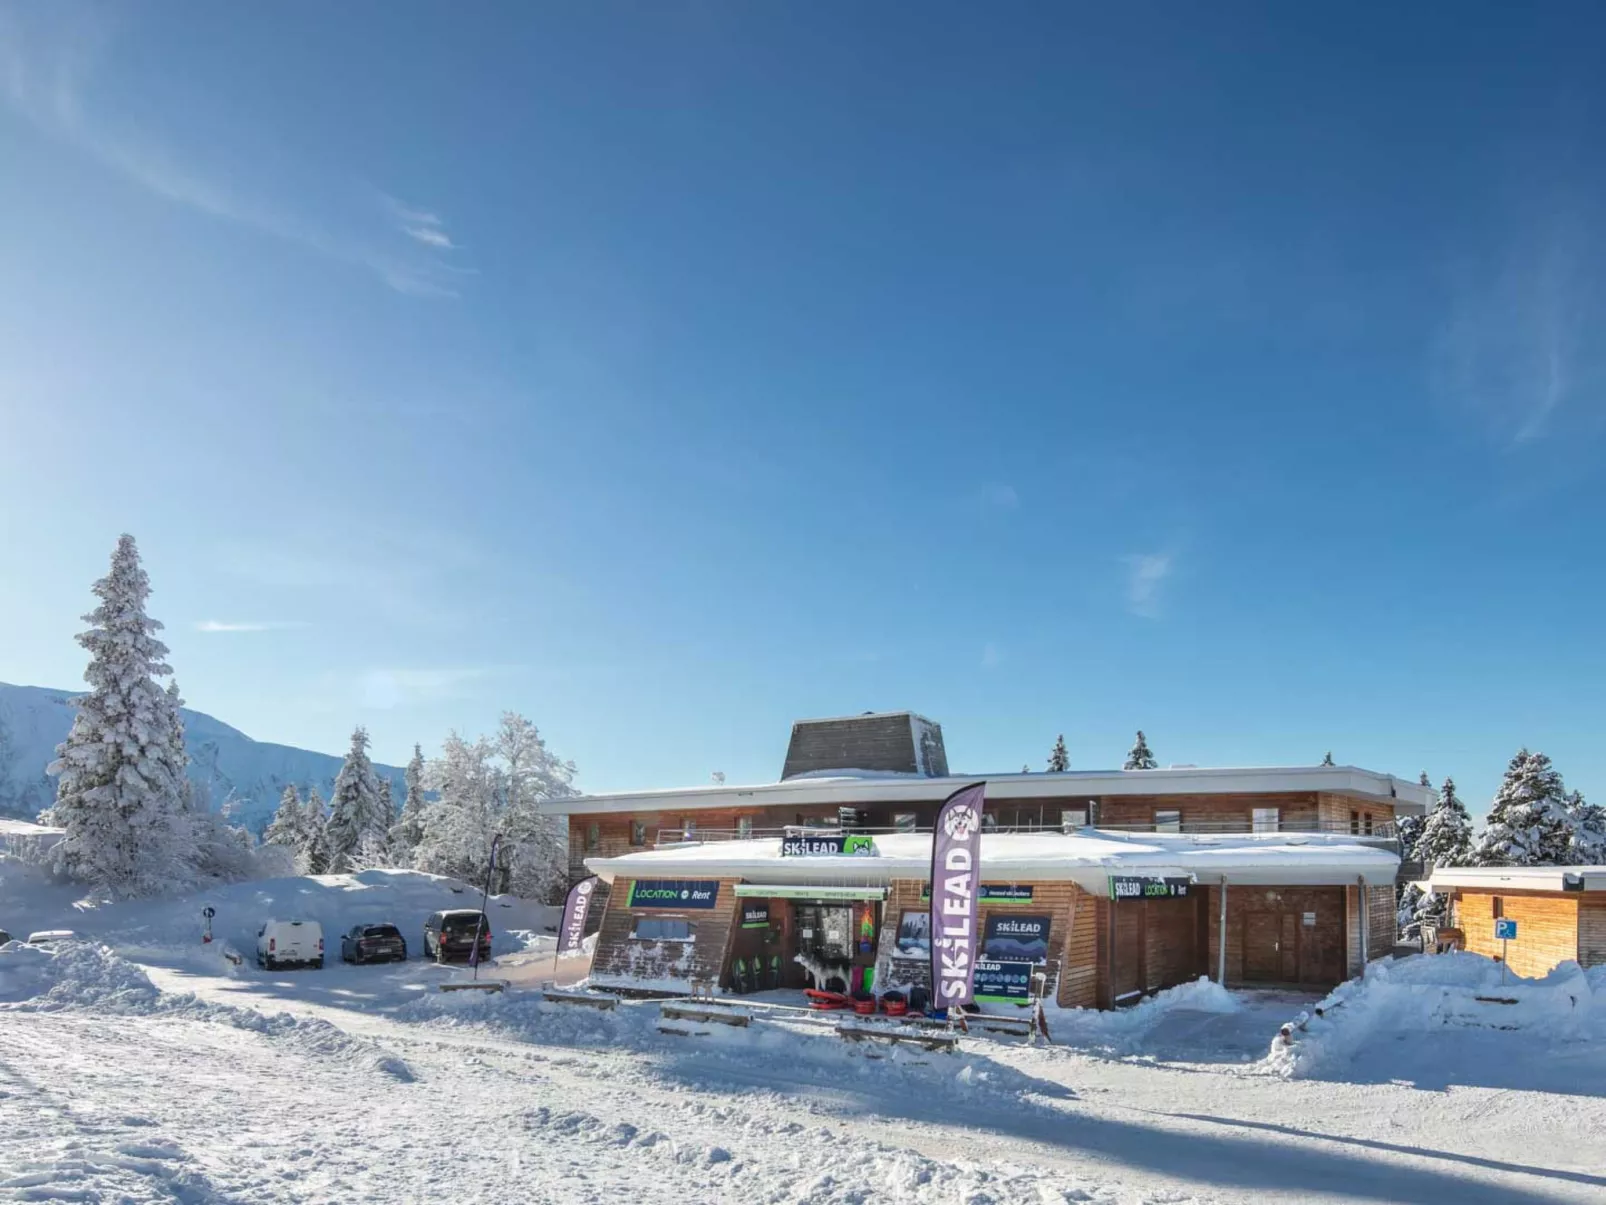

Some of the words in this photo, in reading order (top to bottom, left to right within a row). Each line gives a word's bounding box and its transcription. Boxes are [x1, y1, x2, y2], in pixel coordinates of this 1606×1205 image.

[635, 889, 678, 899] LOCATION
[691, 890, 712, 900] Rent
[1497, 921, 1508, 937] P
